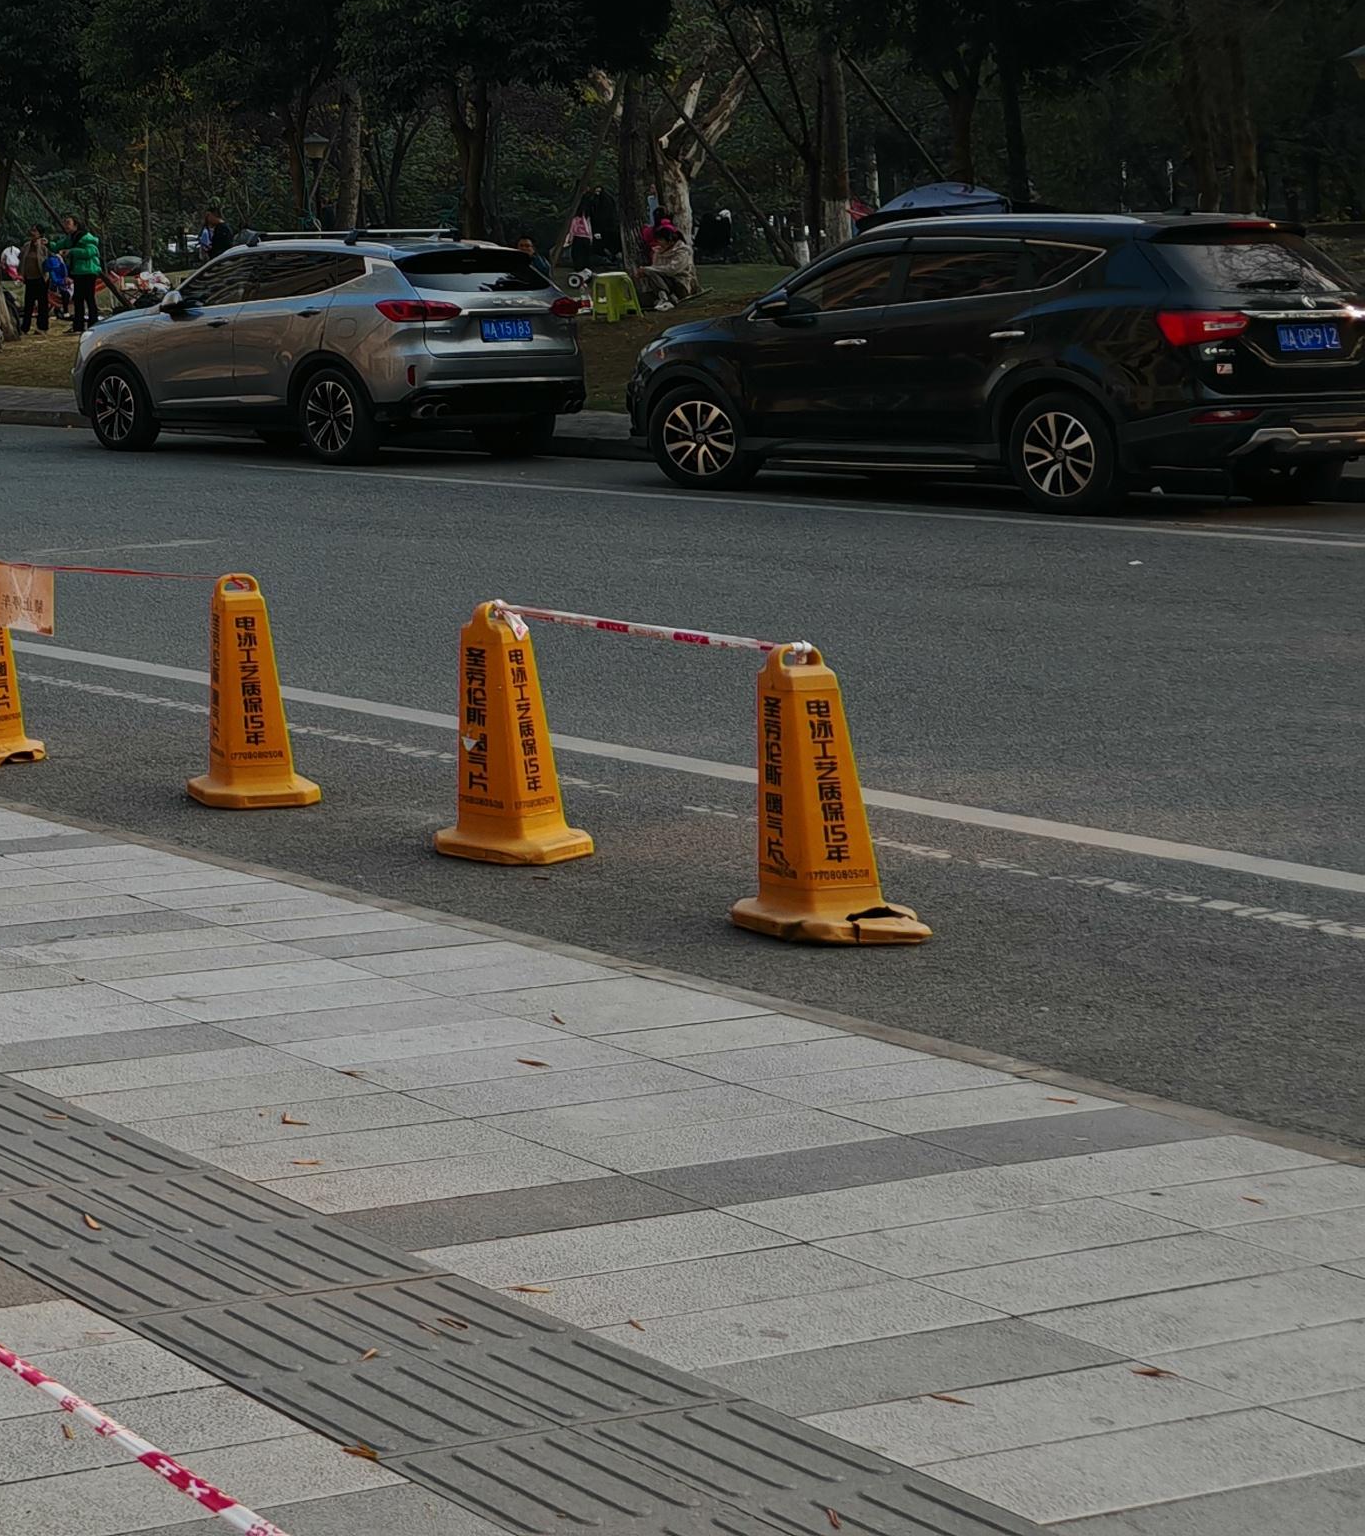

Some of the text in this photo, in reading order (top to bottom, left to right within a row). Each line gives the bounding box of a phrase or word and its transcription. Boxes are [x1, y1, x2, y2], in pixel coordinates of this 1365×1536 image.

[235, 615, 265, 746] 电泳工艺质保15年
[465, 647, 487, 727] 圣劳伦斯
[508, 648, 542, 792] 电泳工艺质保15年
[763, 695, 783, 787] 圣劳伦斯
[805, 699, 851, 863] 电泳工艺质保15年
[765, 791, 785, 865] 暖气片
